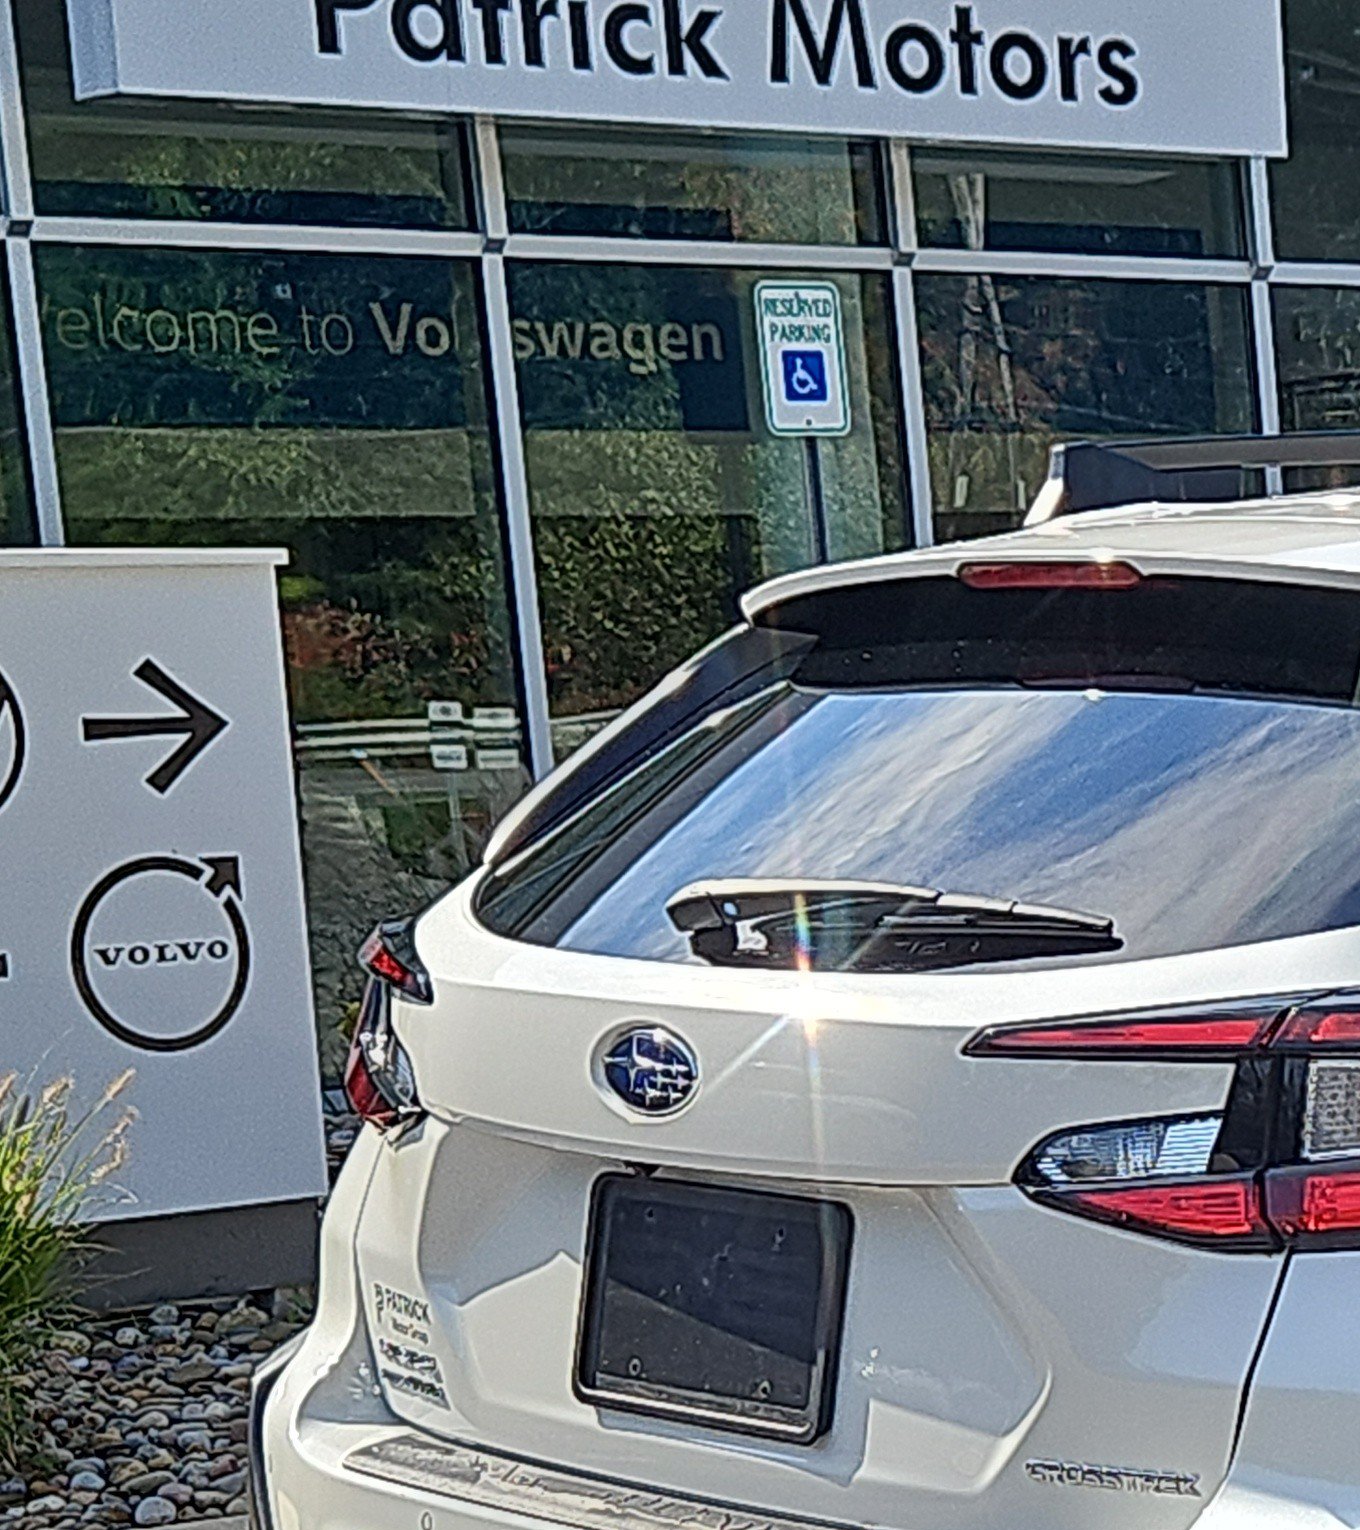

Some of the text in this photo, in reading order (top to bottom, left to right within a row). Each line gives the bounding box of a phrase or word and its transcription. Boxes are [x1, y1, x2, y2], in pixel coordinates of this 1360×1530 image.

[314, 0, 1138, 106] Patrick Motors
[763, 298, 833, 318] RESERVED
[43, 293, 724, 375] elcome to Volswagen
[769, 321, 832, 345] PARKING
[93, 938, 229, 967] VOLVO
